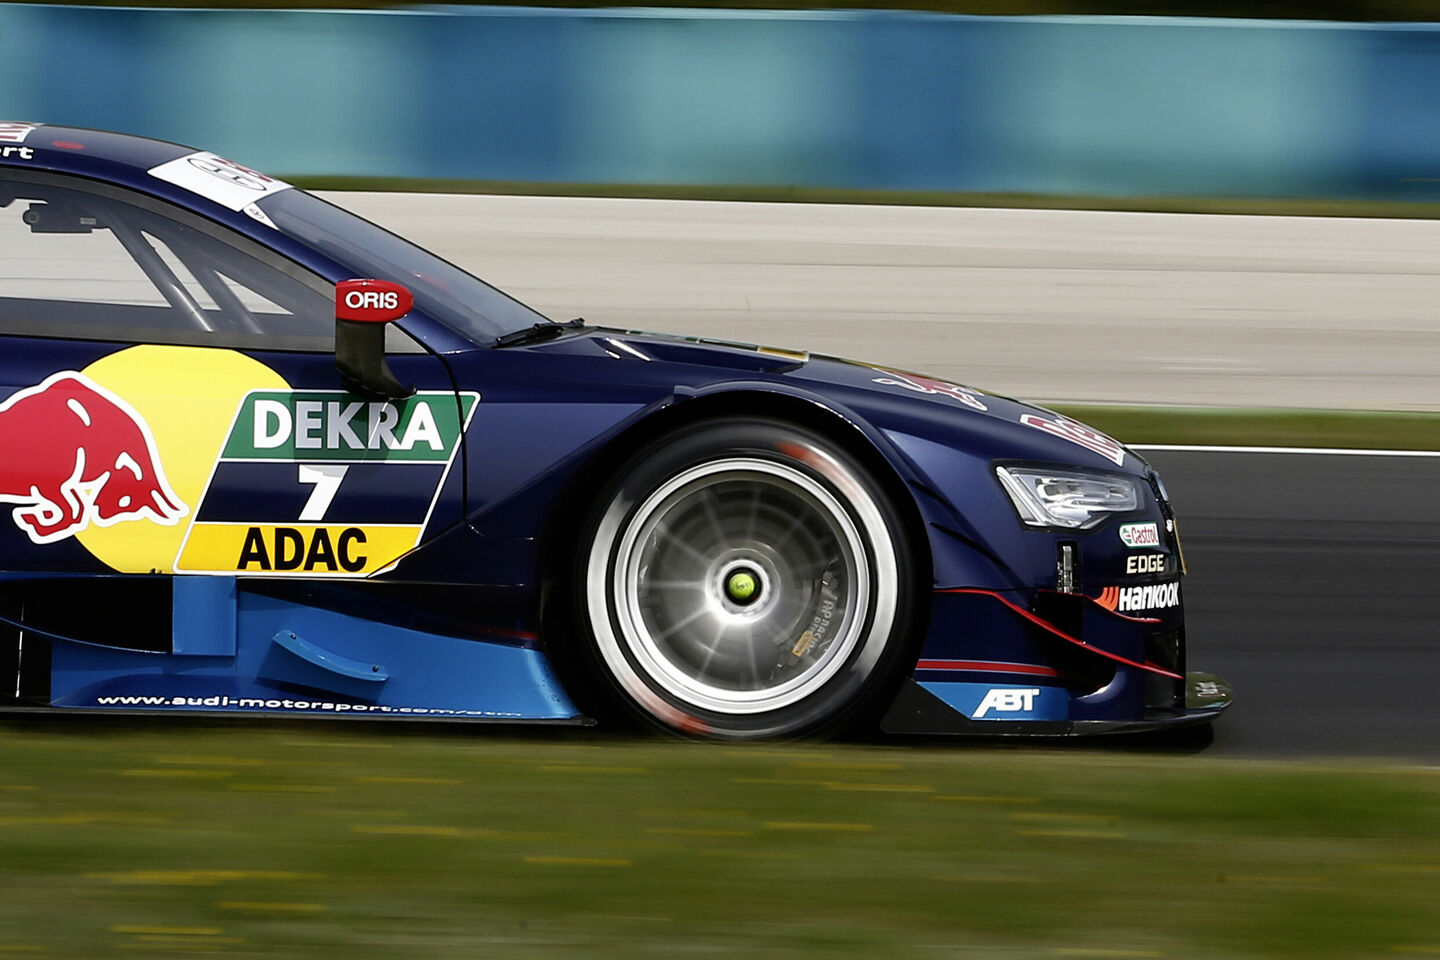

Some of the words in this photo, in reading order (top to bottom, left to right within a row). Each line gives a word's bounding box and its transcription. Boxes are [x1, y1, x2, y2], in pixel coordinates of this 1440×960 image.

[345, 291, 399, 310] ORIS
[253, 400, 444, 451] DEKRA
[298, 464, 350, 521] 7
[237, 527, 368, 572] ADAC
[1131, 525, 1159, 544] Castrol
[1126, 554, 1165, 574] EDGE
[972, 688, 1040, 718] ABT
